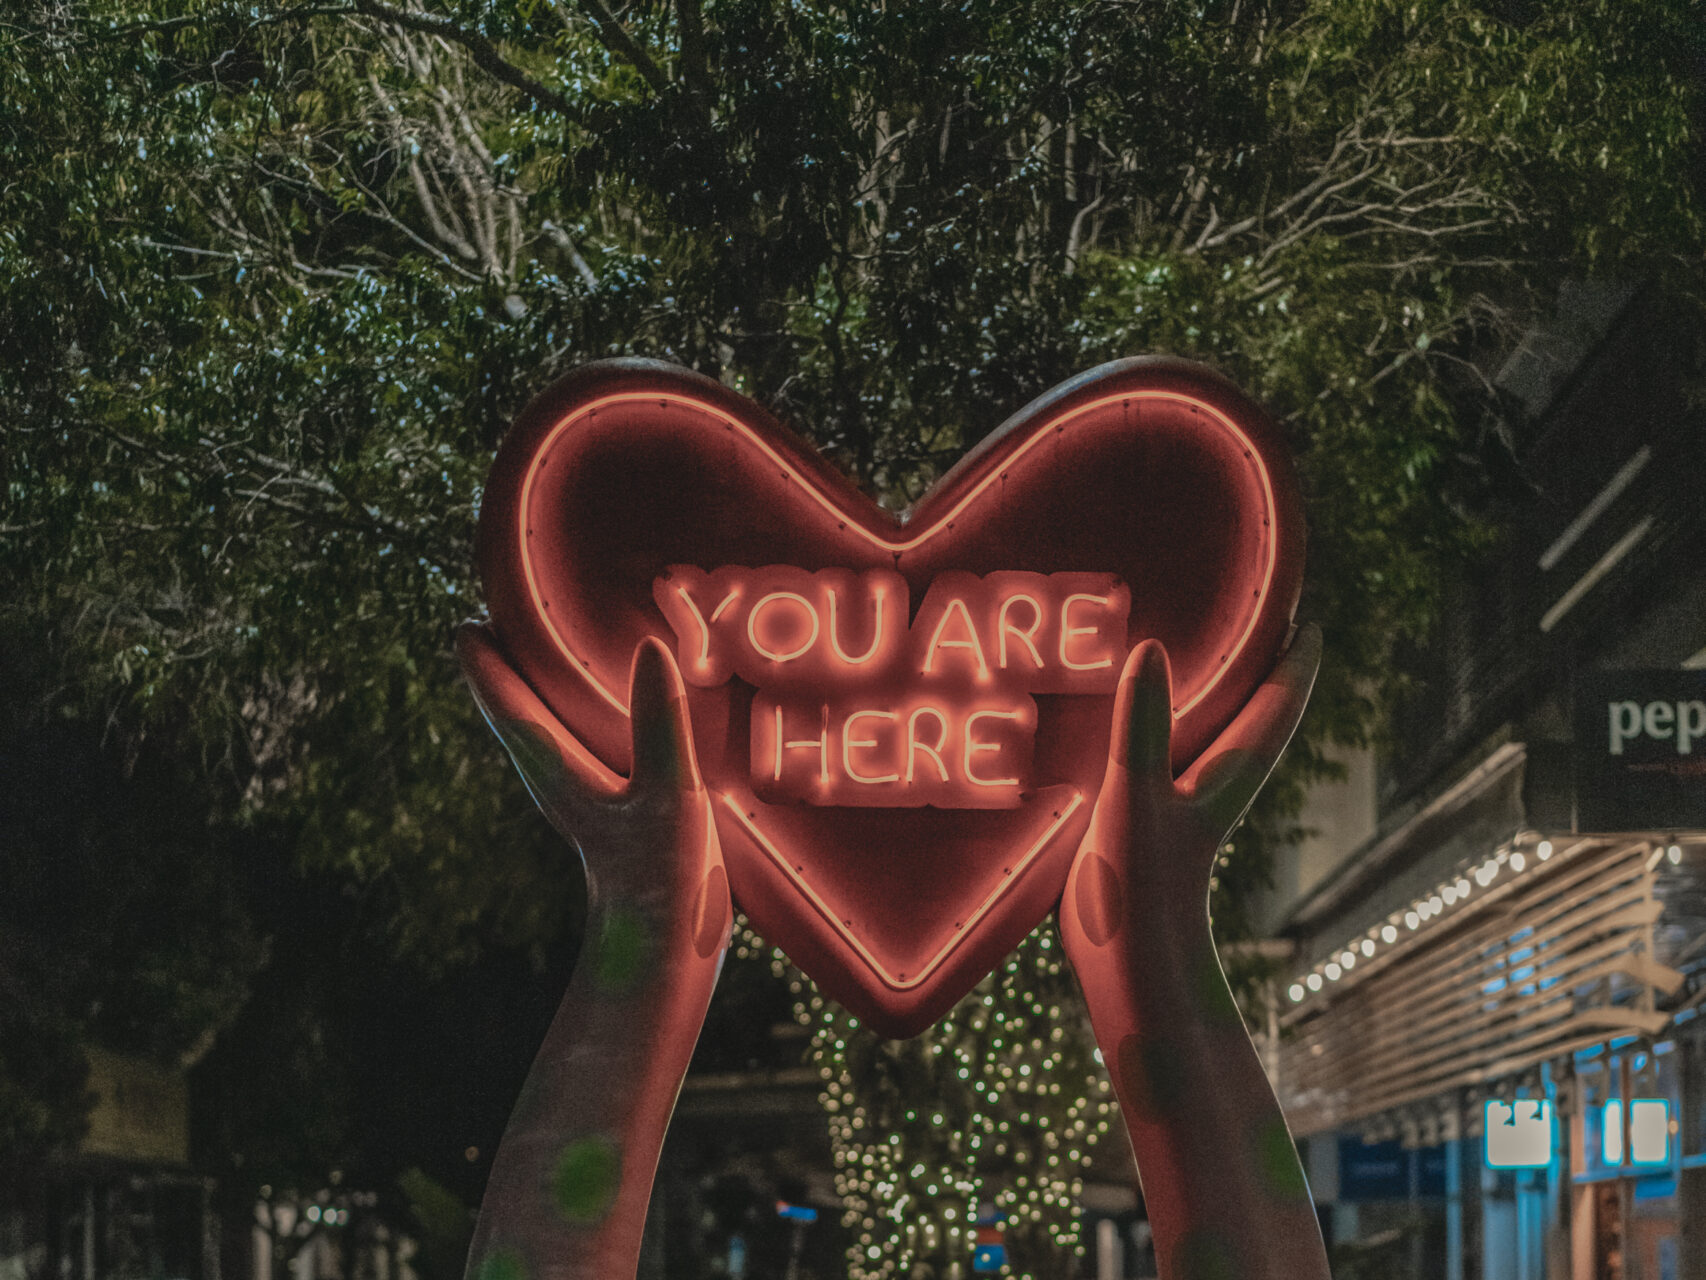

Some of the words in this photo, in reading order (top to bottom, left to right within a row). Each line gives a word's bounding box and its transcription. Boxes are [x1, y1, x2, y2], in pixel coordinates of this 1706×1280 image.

[678, 585, 885, 671] YOU
[921, 593, 1113, 682] ARE
[773, 703, 1020, 787] HERE
[1608, 699, 1706, 755] pep
